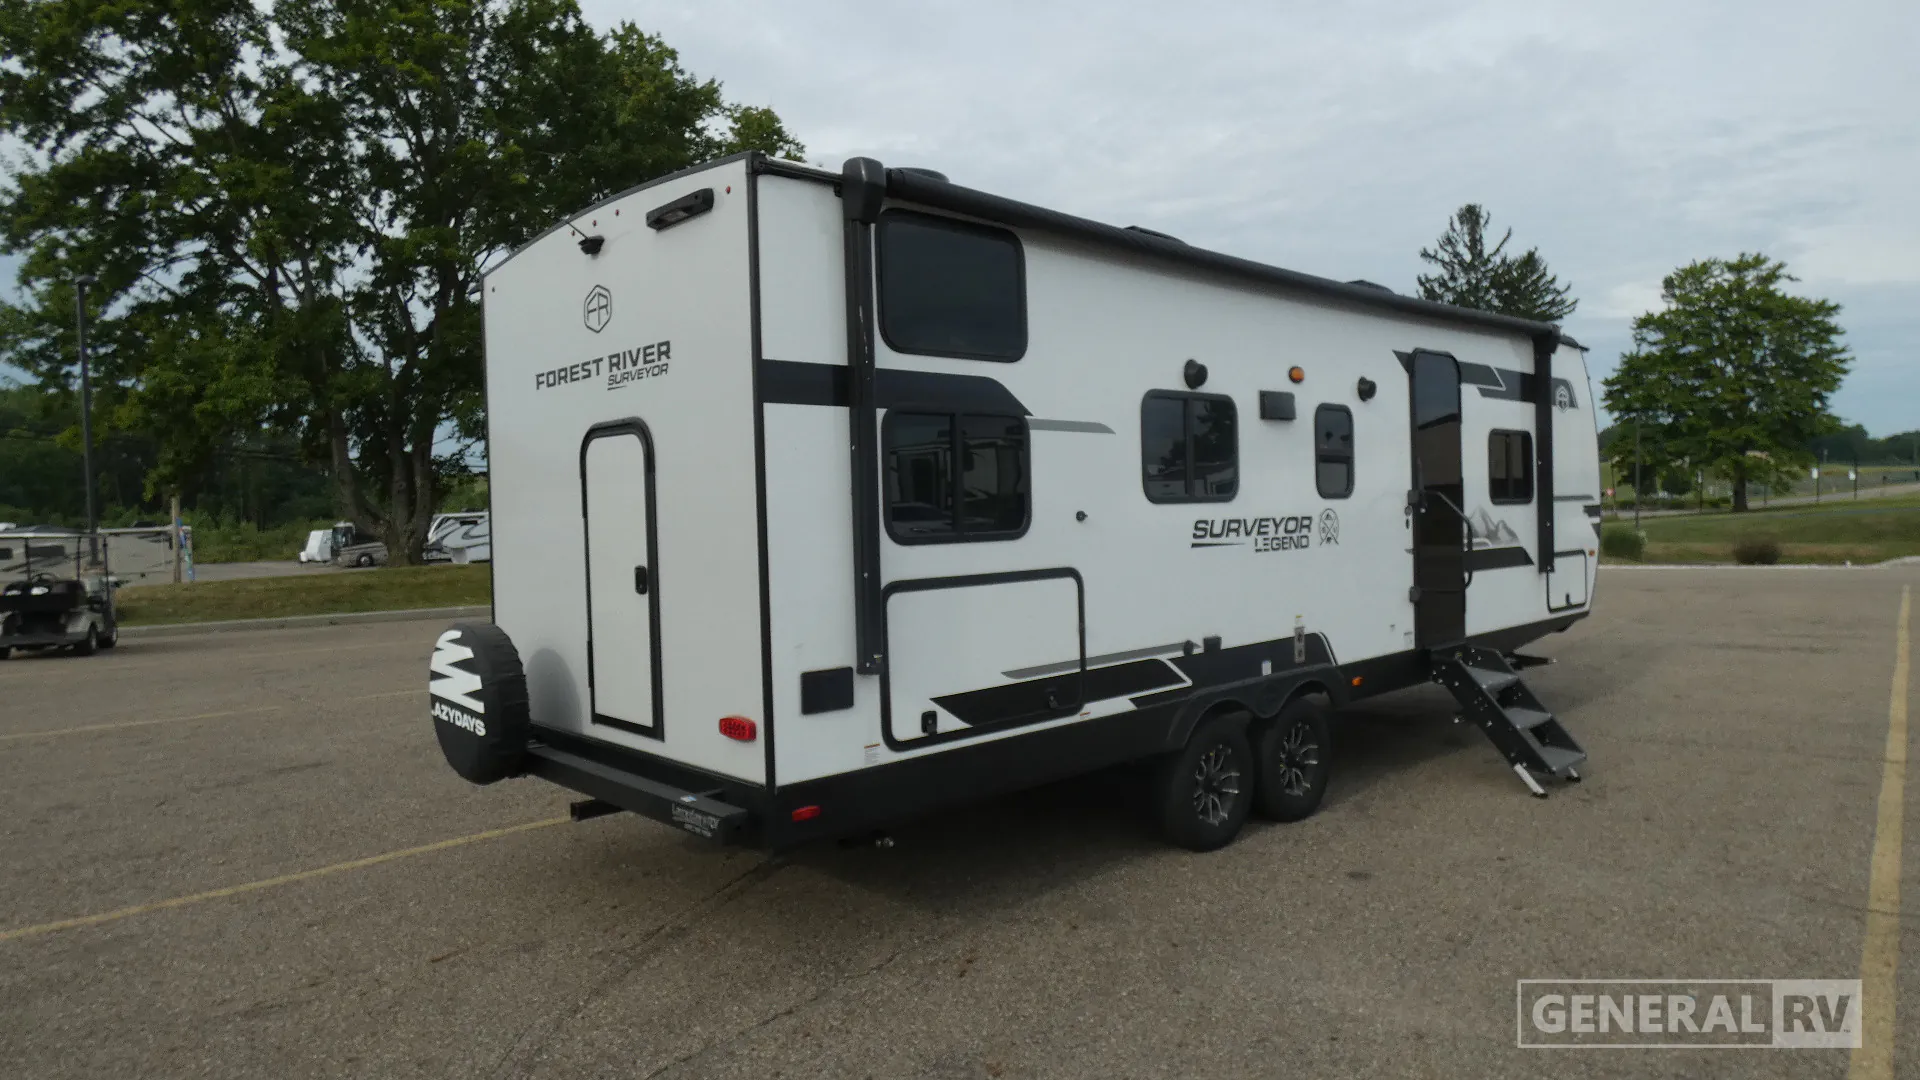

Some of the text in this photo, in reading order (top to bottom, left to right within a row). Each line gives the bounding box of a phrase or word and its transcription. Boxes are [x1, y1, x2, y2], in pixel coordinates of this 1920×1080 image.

[535, 340, 671, 391] FOREST RIVER
[607, 362, 669, 386] SURVEYOR
[1192, 516, 1313, 540] SURVEYOR
[1254, 534, 1310, 553] LEGEND
